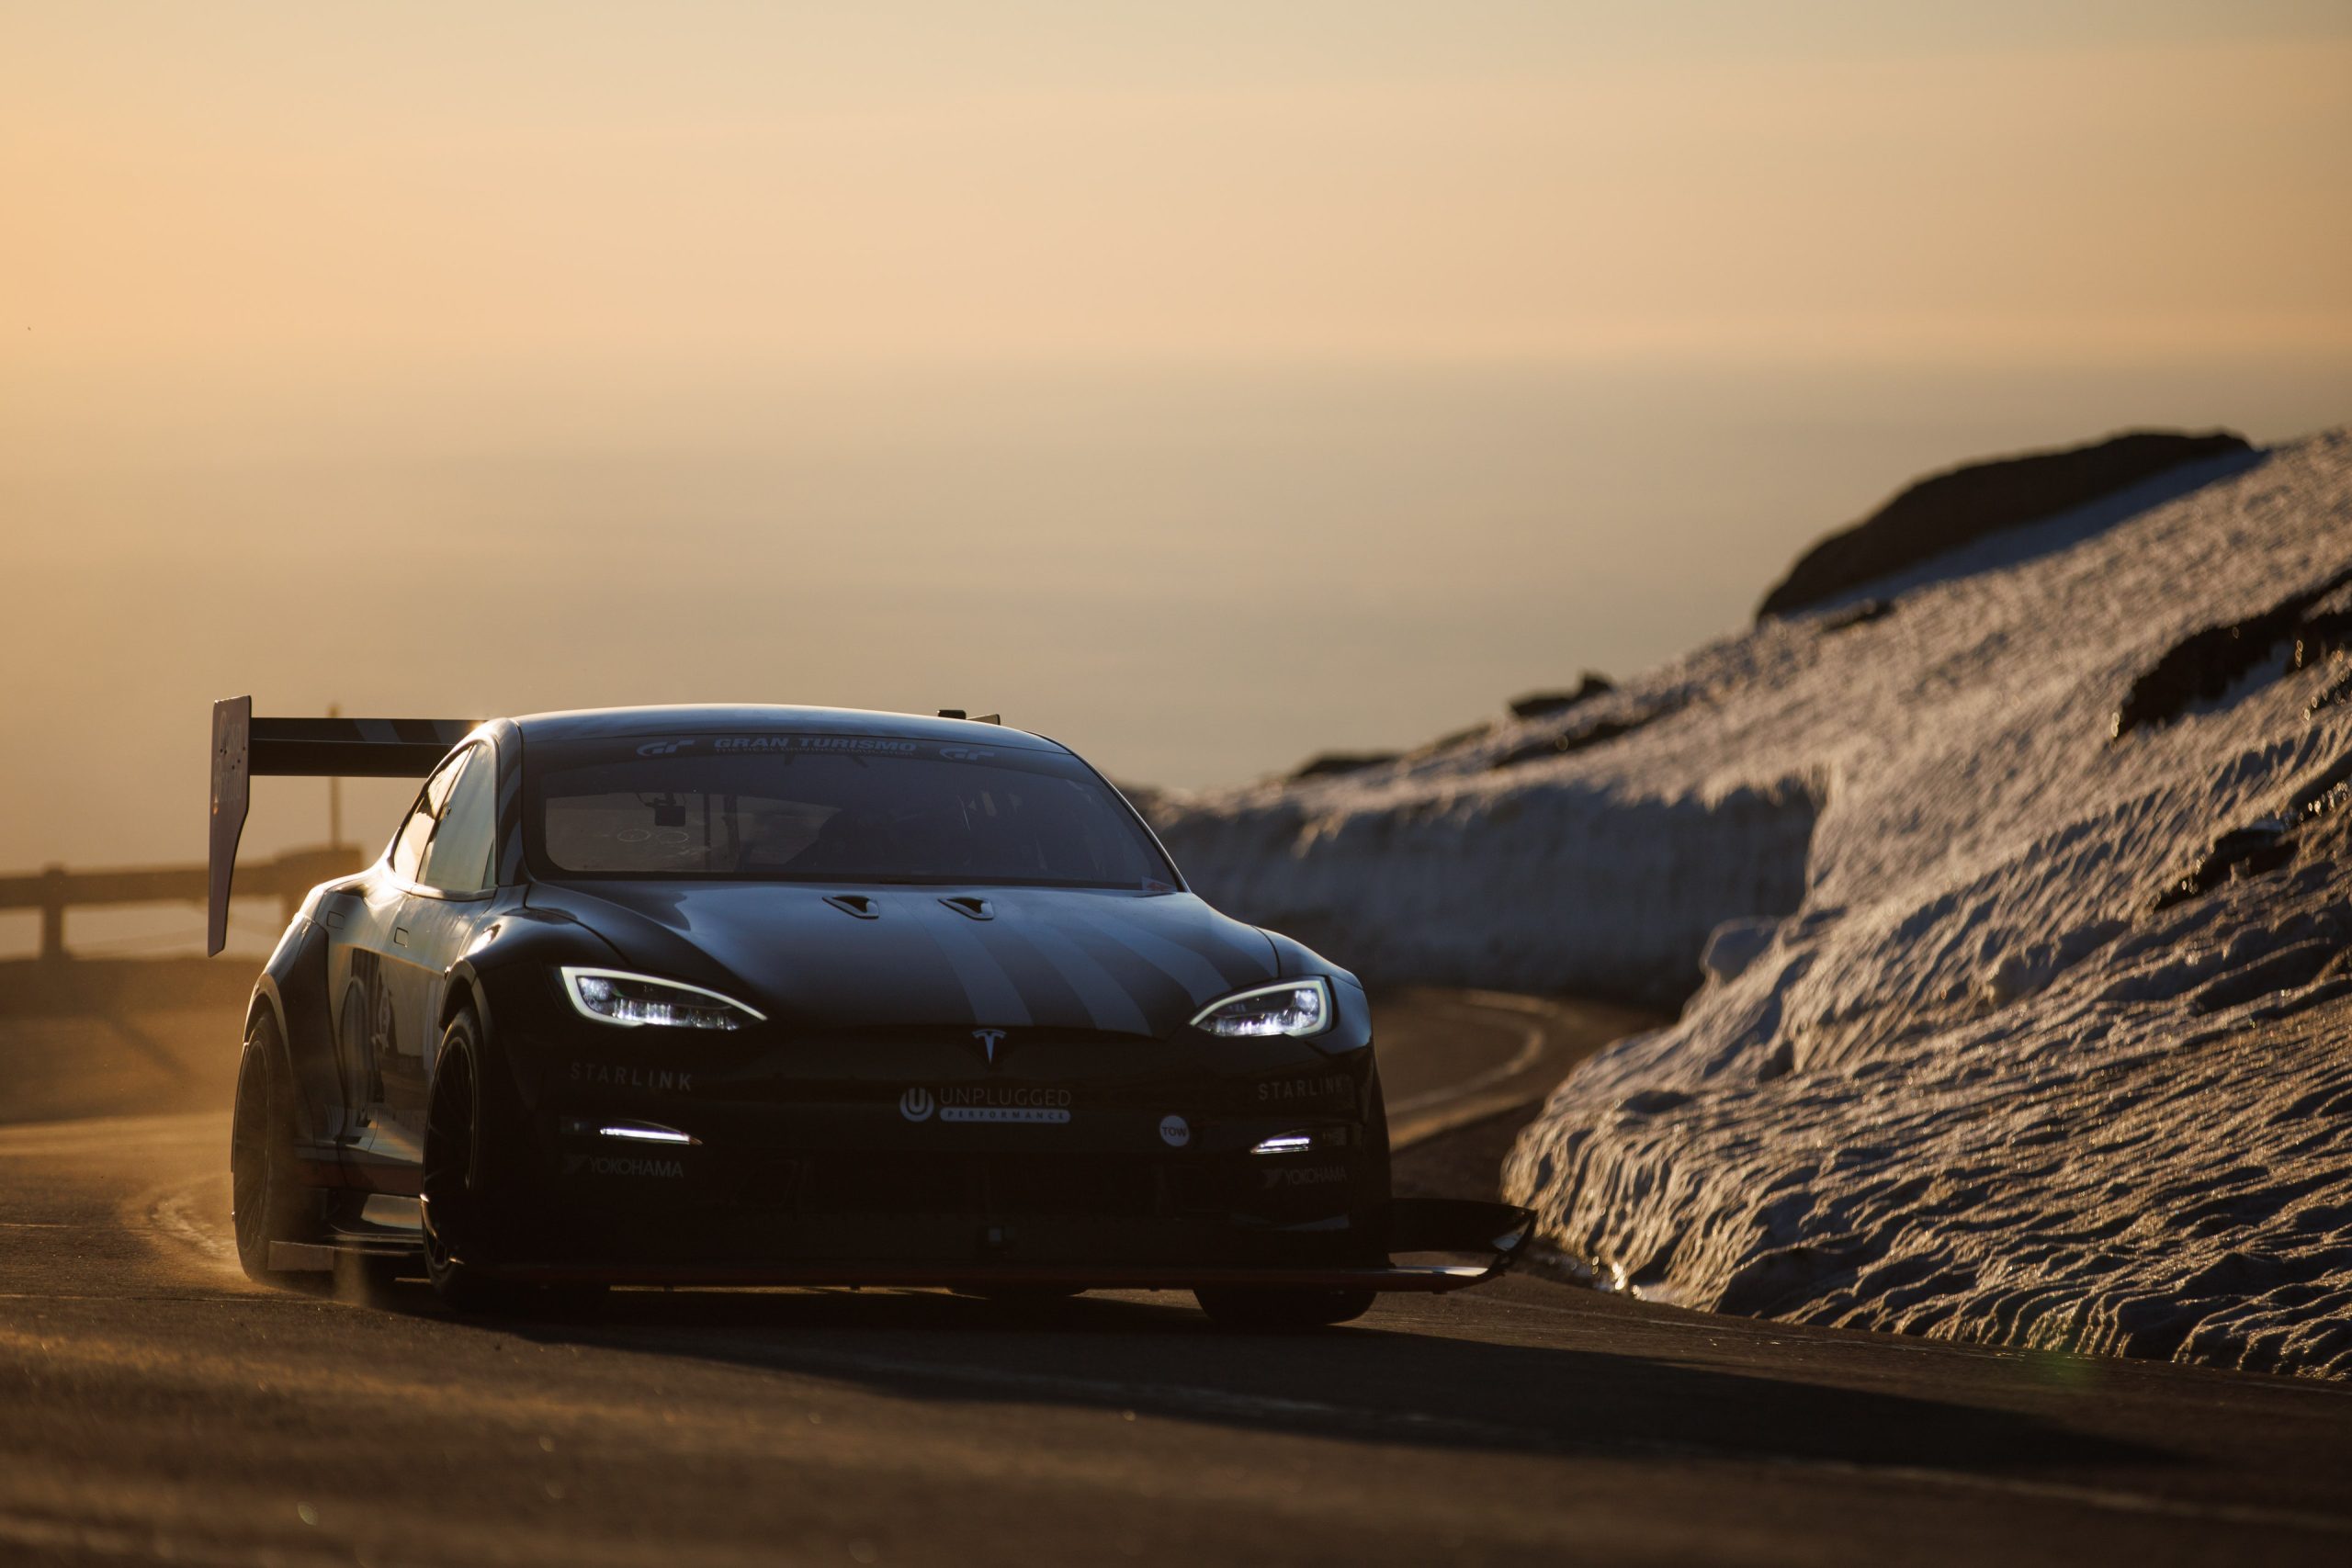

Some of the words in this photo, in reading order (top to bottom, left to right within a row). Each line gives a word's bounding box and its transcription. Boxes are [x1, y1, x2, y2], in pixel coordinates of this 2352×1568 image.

[714, 738, 789, 748] GRAN
[800, 738, 917, 751] TURISMO
[570, 1062, 692, 1092] STARLINK
[940, 1087, 1072, 1107] UNPLUGGED
[947, 1111, 1064, 1121] PERFORMANCE
[1161, 1126, 1188, 1138] TOW
[589, 1156, 684, 1179] YOKOHAMA
[1285, 1165, 1348, 1186] YOKOHAMA
